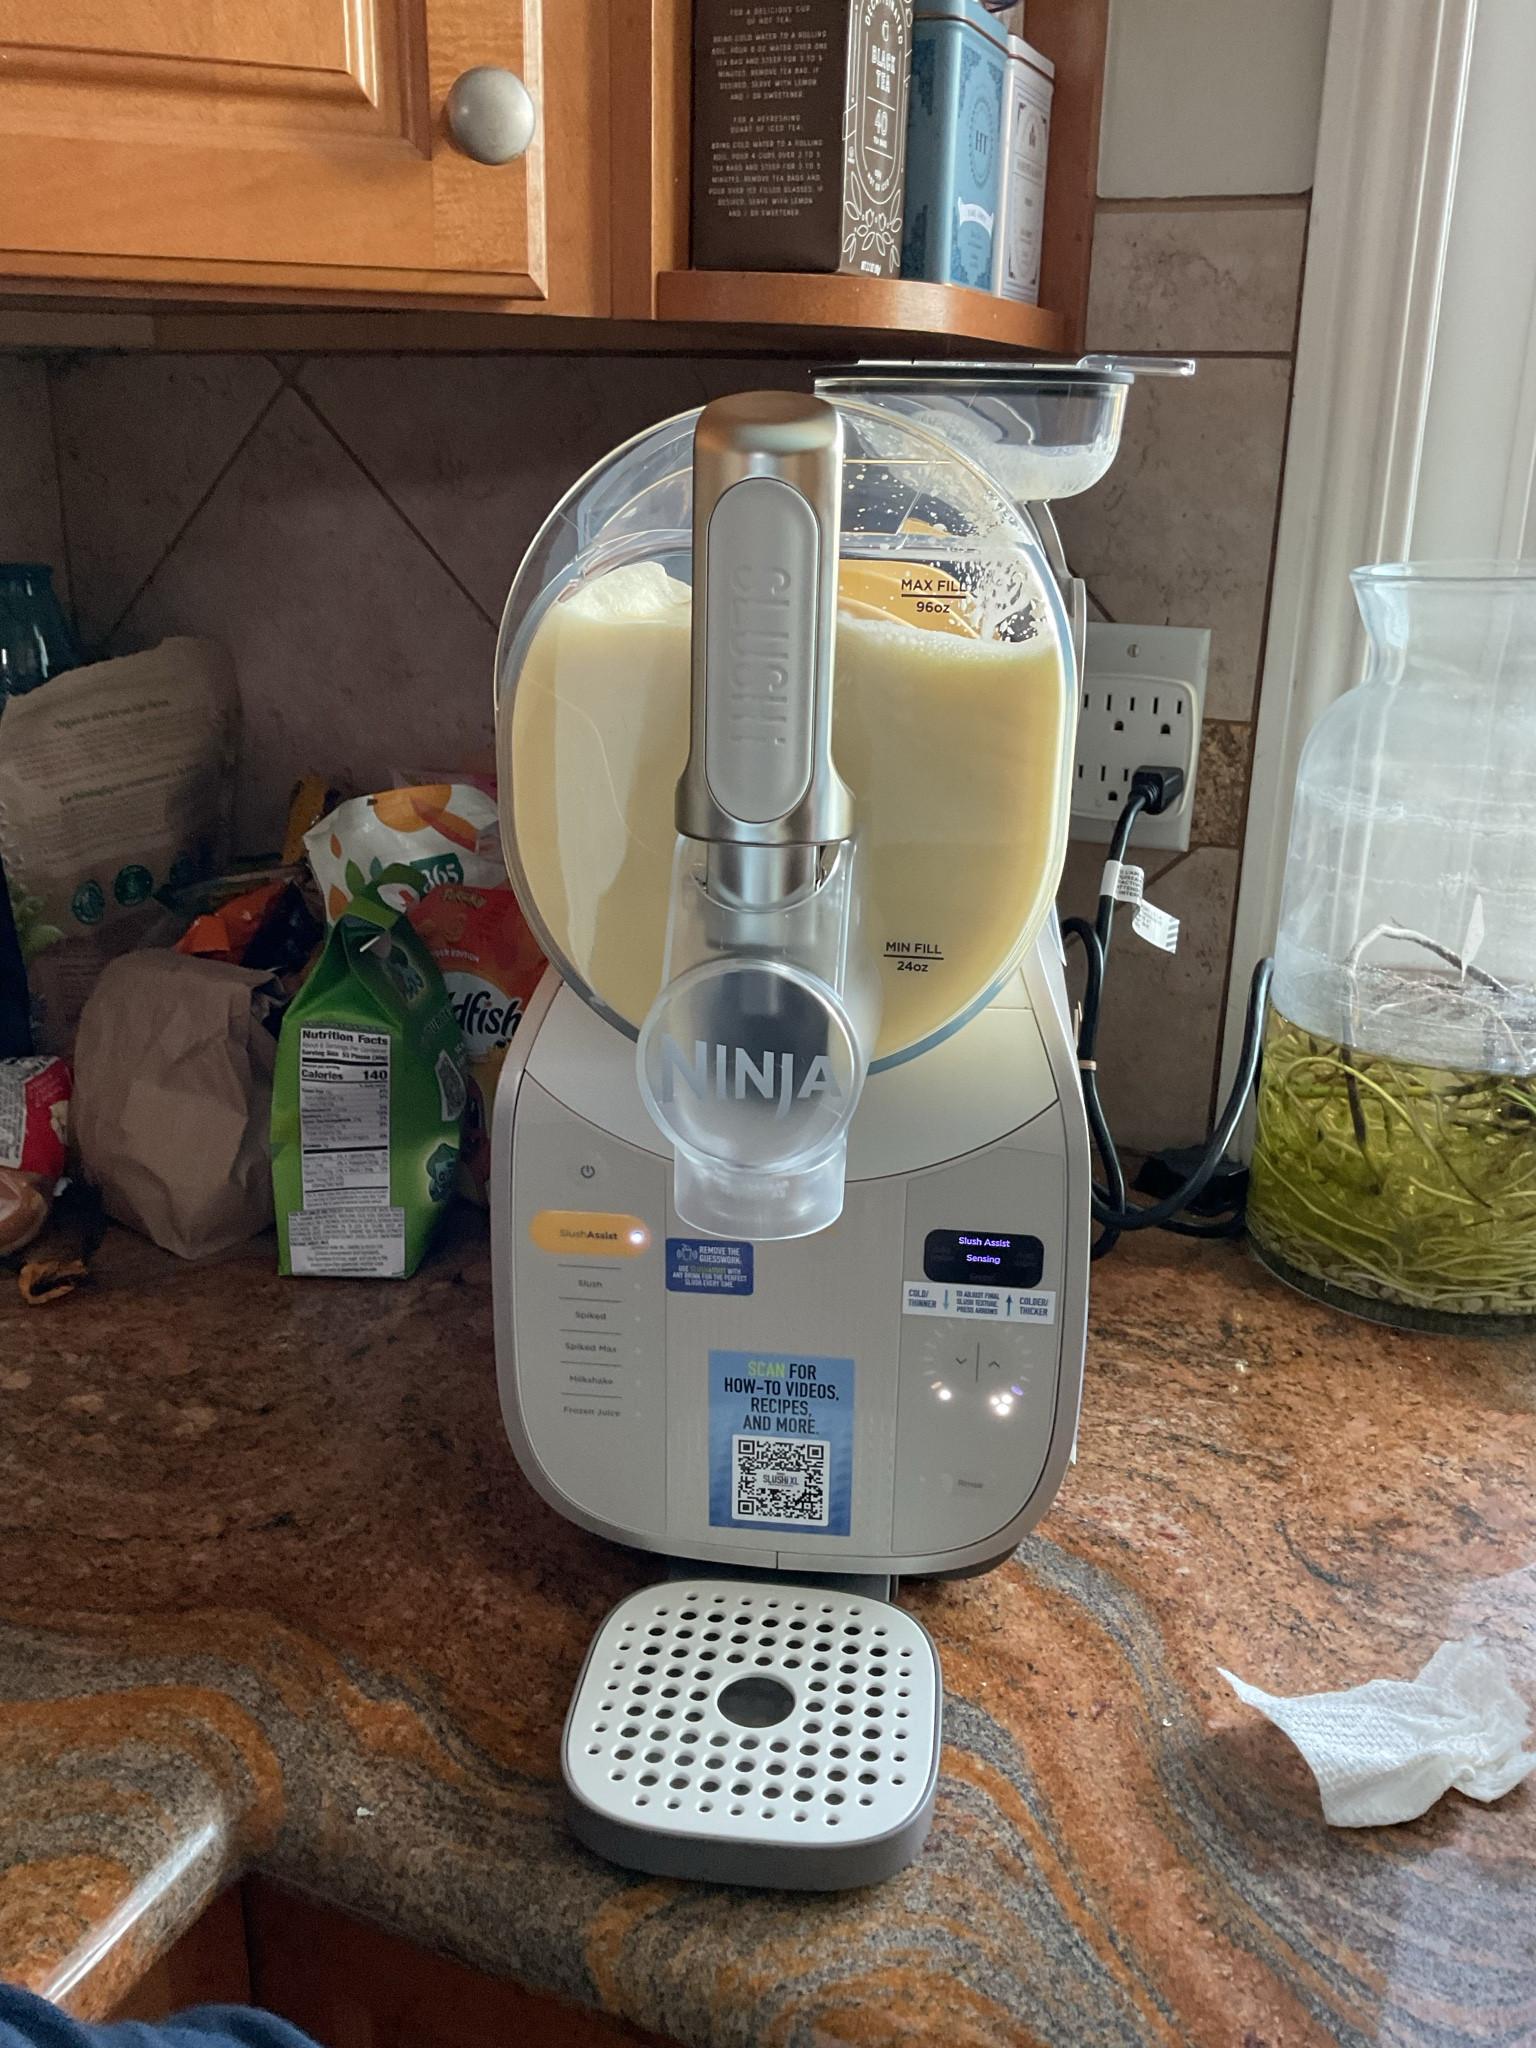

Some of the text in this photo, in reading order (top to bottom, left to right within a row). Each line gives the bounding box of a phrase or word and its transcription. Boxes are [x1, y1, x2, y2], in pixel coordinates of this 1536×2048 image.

[872, 45, 896, 75] BLACK
[875, 69, 891, 93] TEA
[874, 109, 889, 136] 40
[901, 579, 967, 592] MAX FILL
[916, 601, 950, 614] 96oz
[423, 863, 460, 893] 365
[885, 942, 942, 954] MIN FILL
[897, 961, 928, 972] 24oz
[302, 1030, 388, 1045] Nutrition Facts
[301, 1069, 388, 1080] Calories 140
[661, 1033, 843, 1122] NINJA
[560, 1229, 618, 1240] SlushAssist
[958, 1236, 1011, 1248] Slush Assist
[699, 1245, 740, 1256] REMOVE THE
[699, 1254, 742, 1264] GUESSWORK.
[966, 1254, 1001, 1264] Sensing
[672, 1271, 683, 1279] ANY
[684, 1272, 700, 1280] DRINK
[713, 1273, 723, 1281] THE
[724, 1274, 747, 1282] PERFECT
[578, 1280, 602, 1288] Slush
[908, 1289, 929, 1298] COLD/
[908, 1299, 937, 1308] THINNER
[1019, 1297, 1049, 1306] COLDER/
[575, 1311, 607, 1320] Spiked
[975, 1307, 998, 1315] ARROWS
[1020, 1306, 1048, 1316] THICKER
[565, 1342, 617, 1353] Spiked Max
[748, 1361, 817, 1380] SCAN FOR
[569, 1375, 614, 1385] Milkshake
[724, 1377, 781, 1396] HOW-TO
[563, 1406, 621, 1417] Frozen Juice
[751, 1397, 812, 1417] RECIPES,
[743, 1415, 819, 1435] AND MORE.
[790, 1476, 799, 1486] XL
